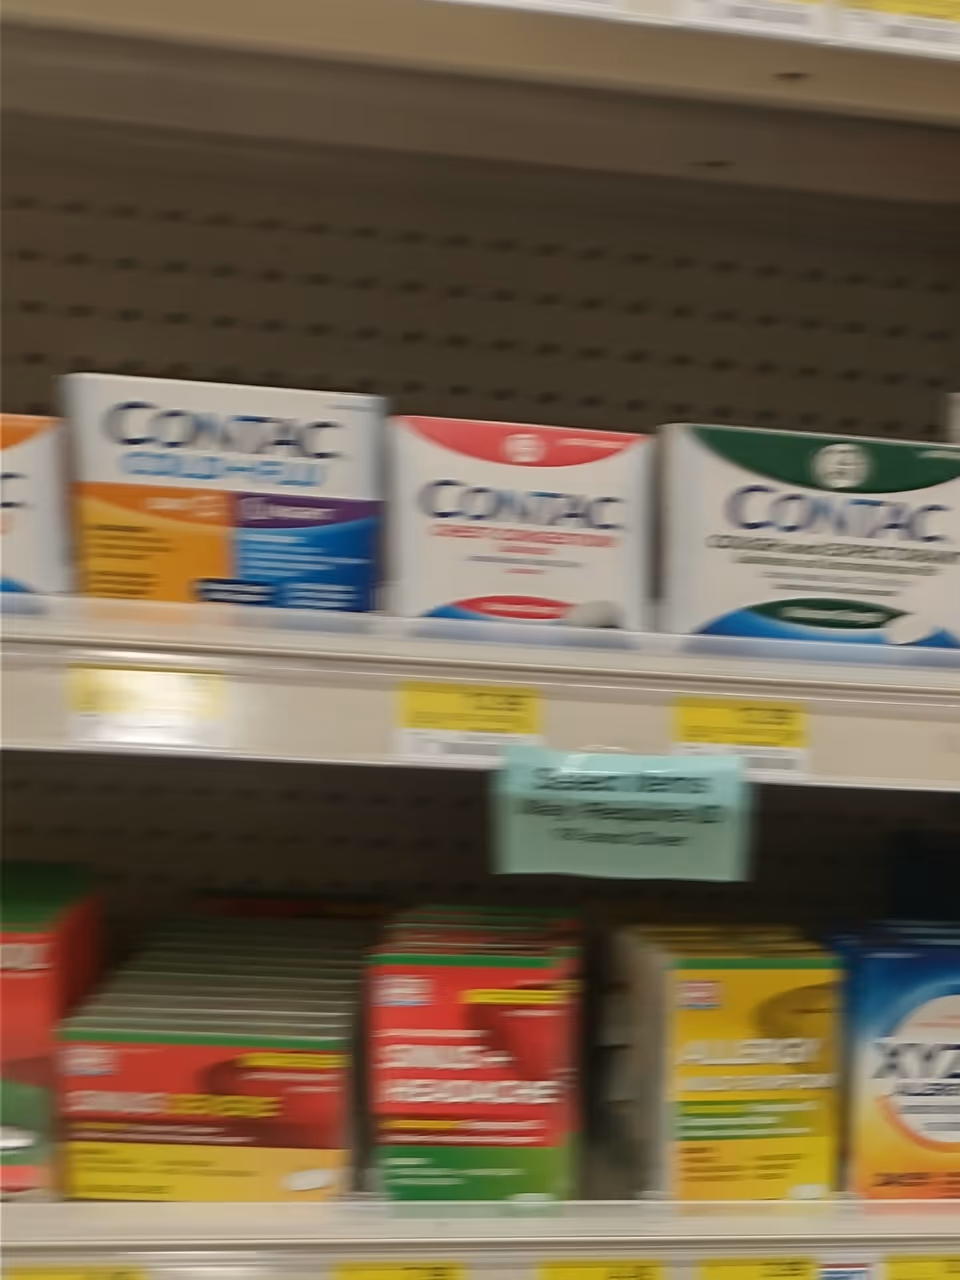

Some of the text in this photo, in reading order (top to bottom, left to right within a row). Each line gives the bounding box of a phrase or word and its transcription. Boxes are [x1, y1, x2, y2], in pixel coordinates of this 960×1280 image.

[106, 401, 342, 459] CONTAC
[418, 480, 626, 530] CONTAC
[725, 485, 952, 542] CONTAC
